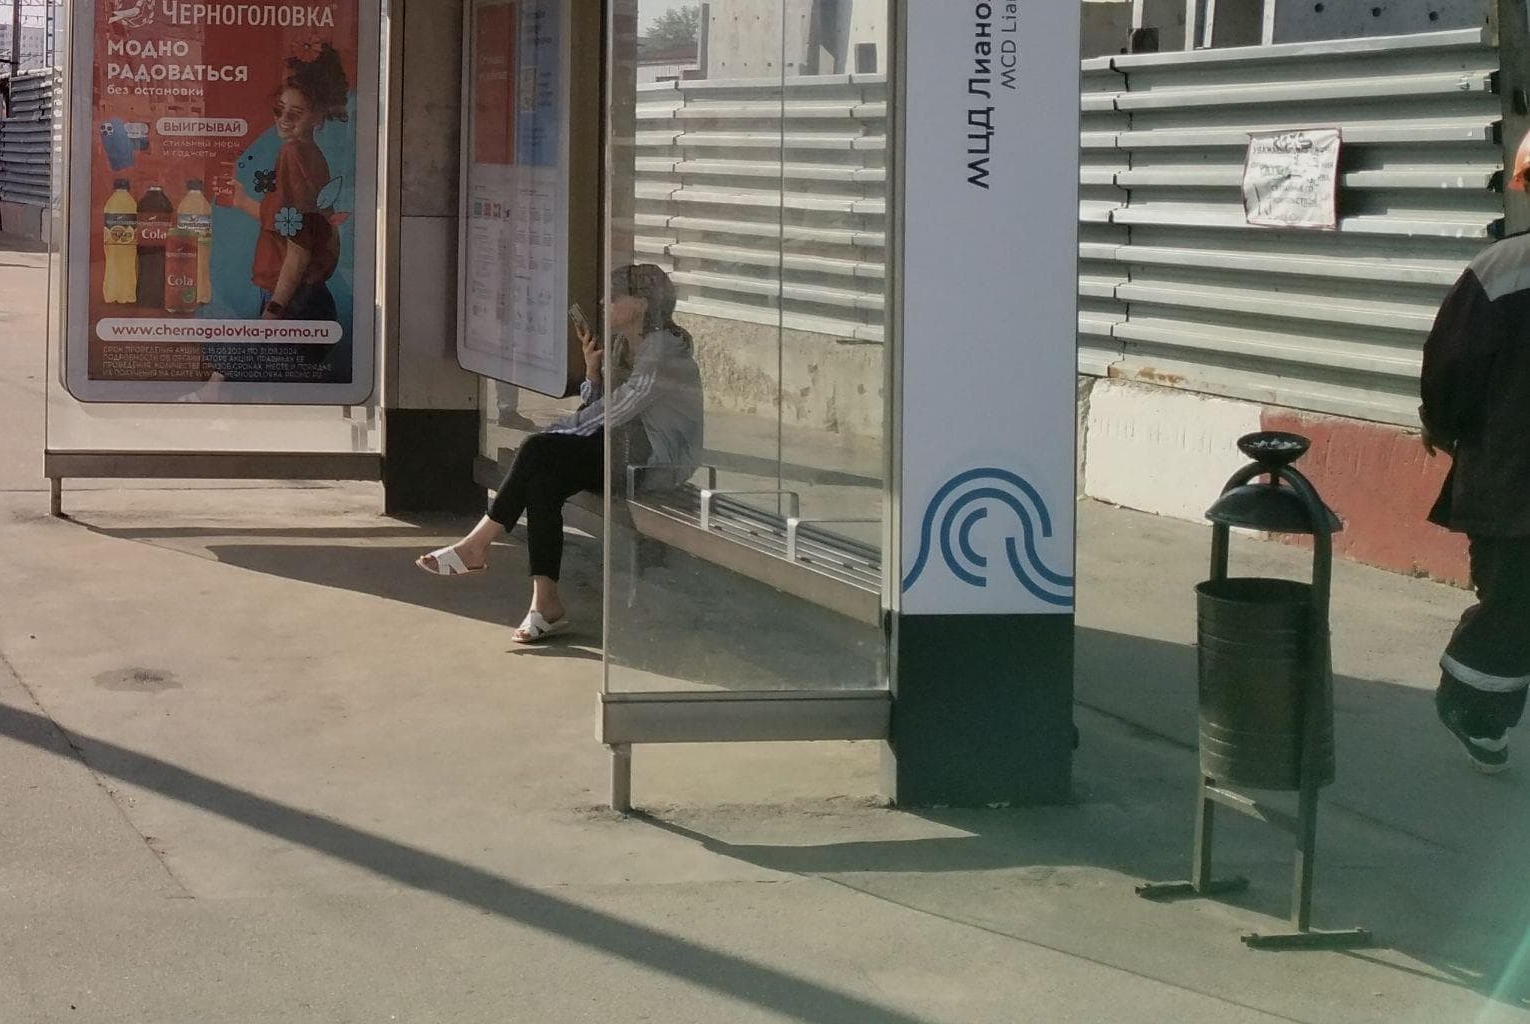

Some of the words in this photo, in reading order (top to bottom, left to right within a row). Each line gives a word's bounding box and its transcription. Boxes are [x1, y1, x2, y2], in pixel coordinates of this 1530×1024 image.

[107, 40, 189, 58] МОДНО
[1001, 39, 1018, 90] MCD
[107, 64, 248, 82] РАДОВАТЬСЯ
[107, 85, 129, 95] без
[134, 86, 204, 96] остановки
[163, 120, 242, 133] ВЫИГРЫВАЙ
[967, 106, 995, 189] МЦД
[141, 228, 167, 240] Cola
[167, 274, 194, 287] Cola
[111, 324, 330, 340] www.chernogolovka-promo.ru
